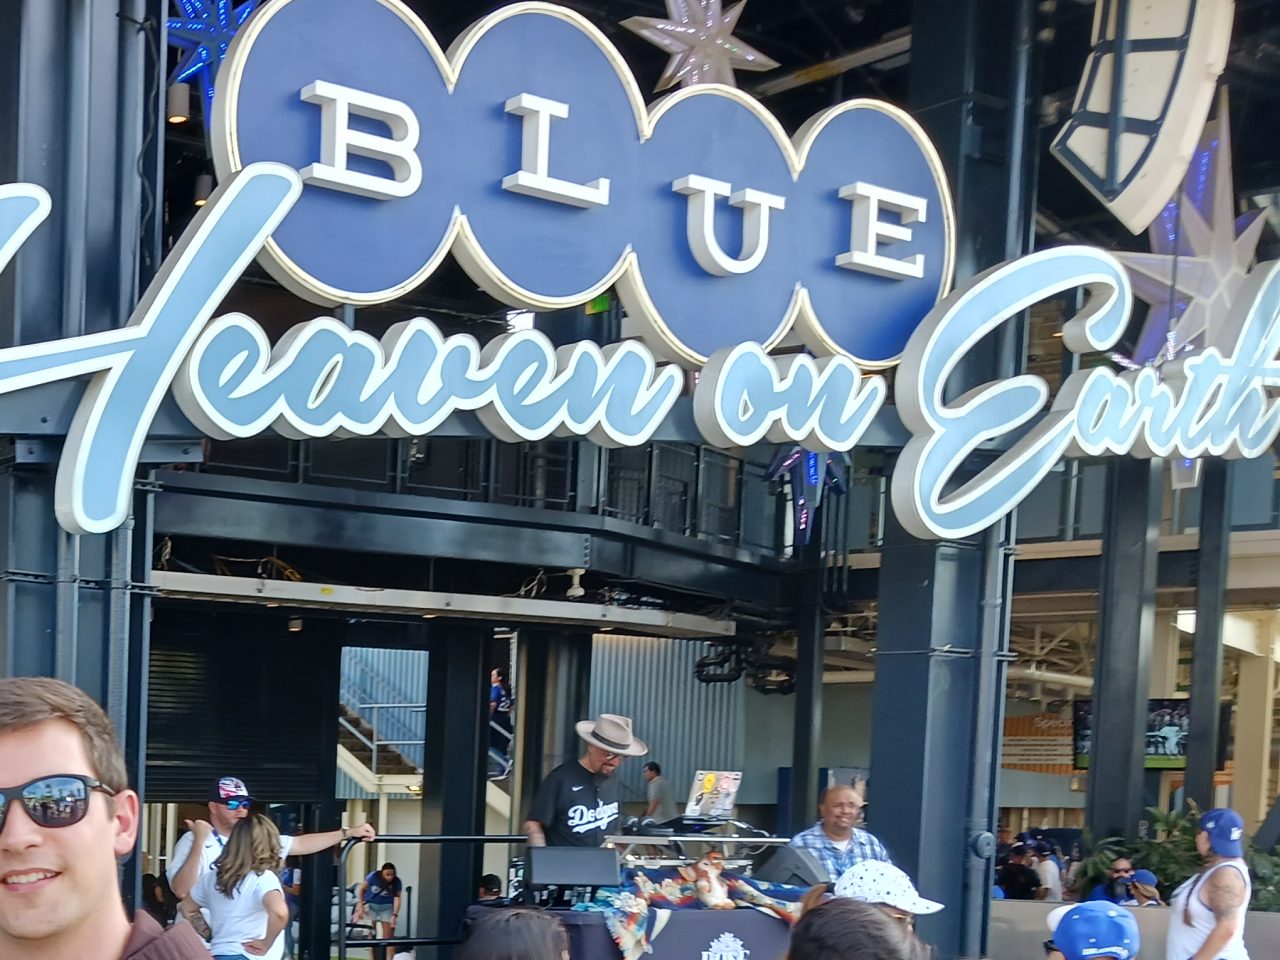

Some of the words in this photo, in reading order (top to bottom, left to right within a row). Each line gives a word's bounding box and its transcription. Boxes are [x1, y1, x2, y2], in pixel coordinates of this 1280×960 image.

[299, 80, 928, 279] BLUE
[695, 341, 887, 452] on
[892, 245, 1280, 541] Earth
